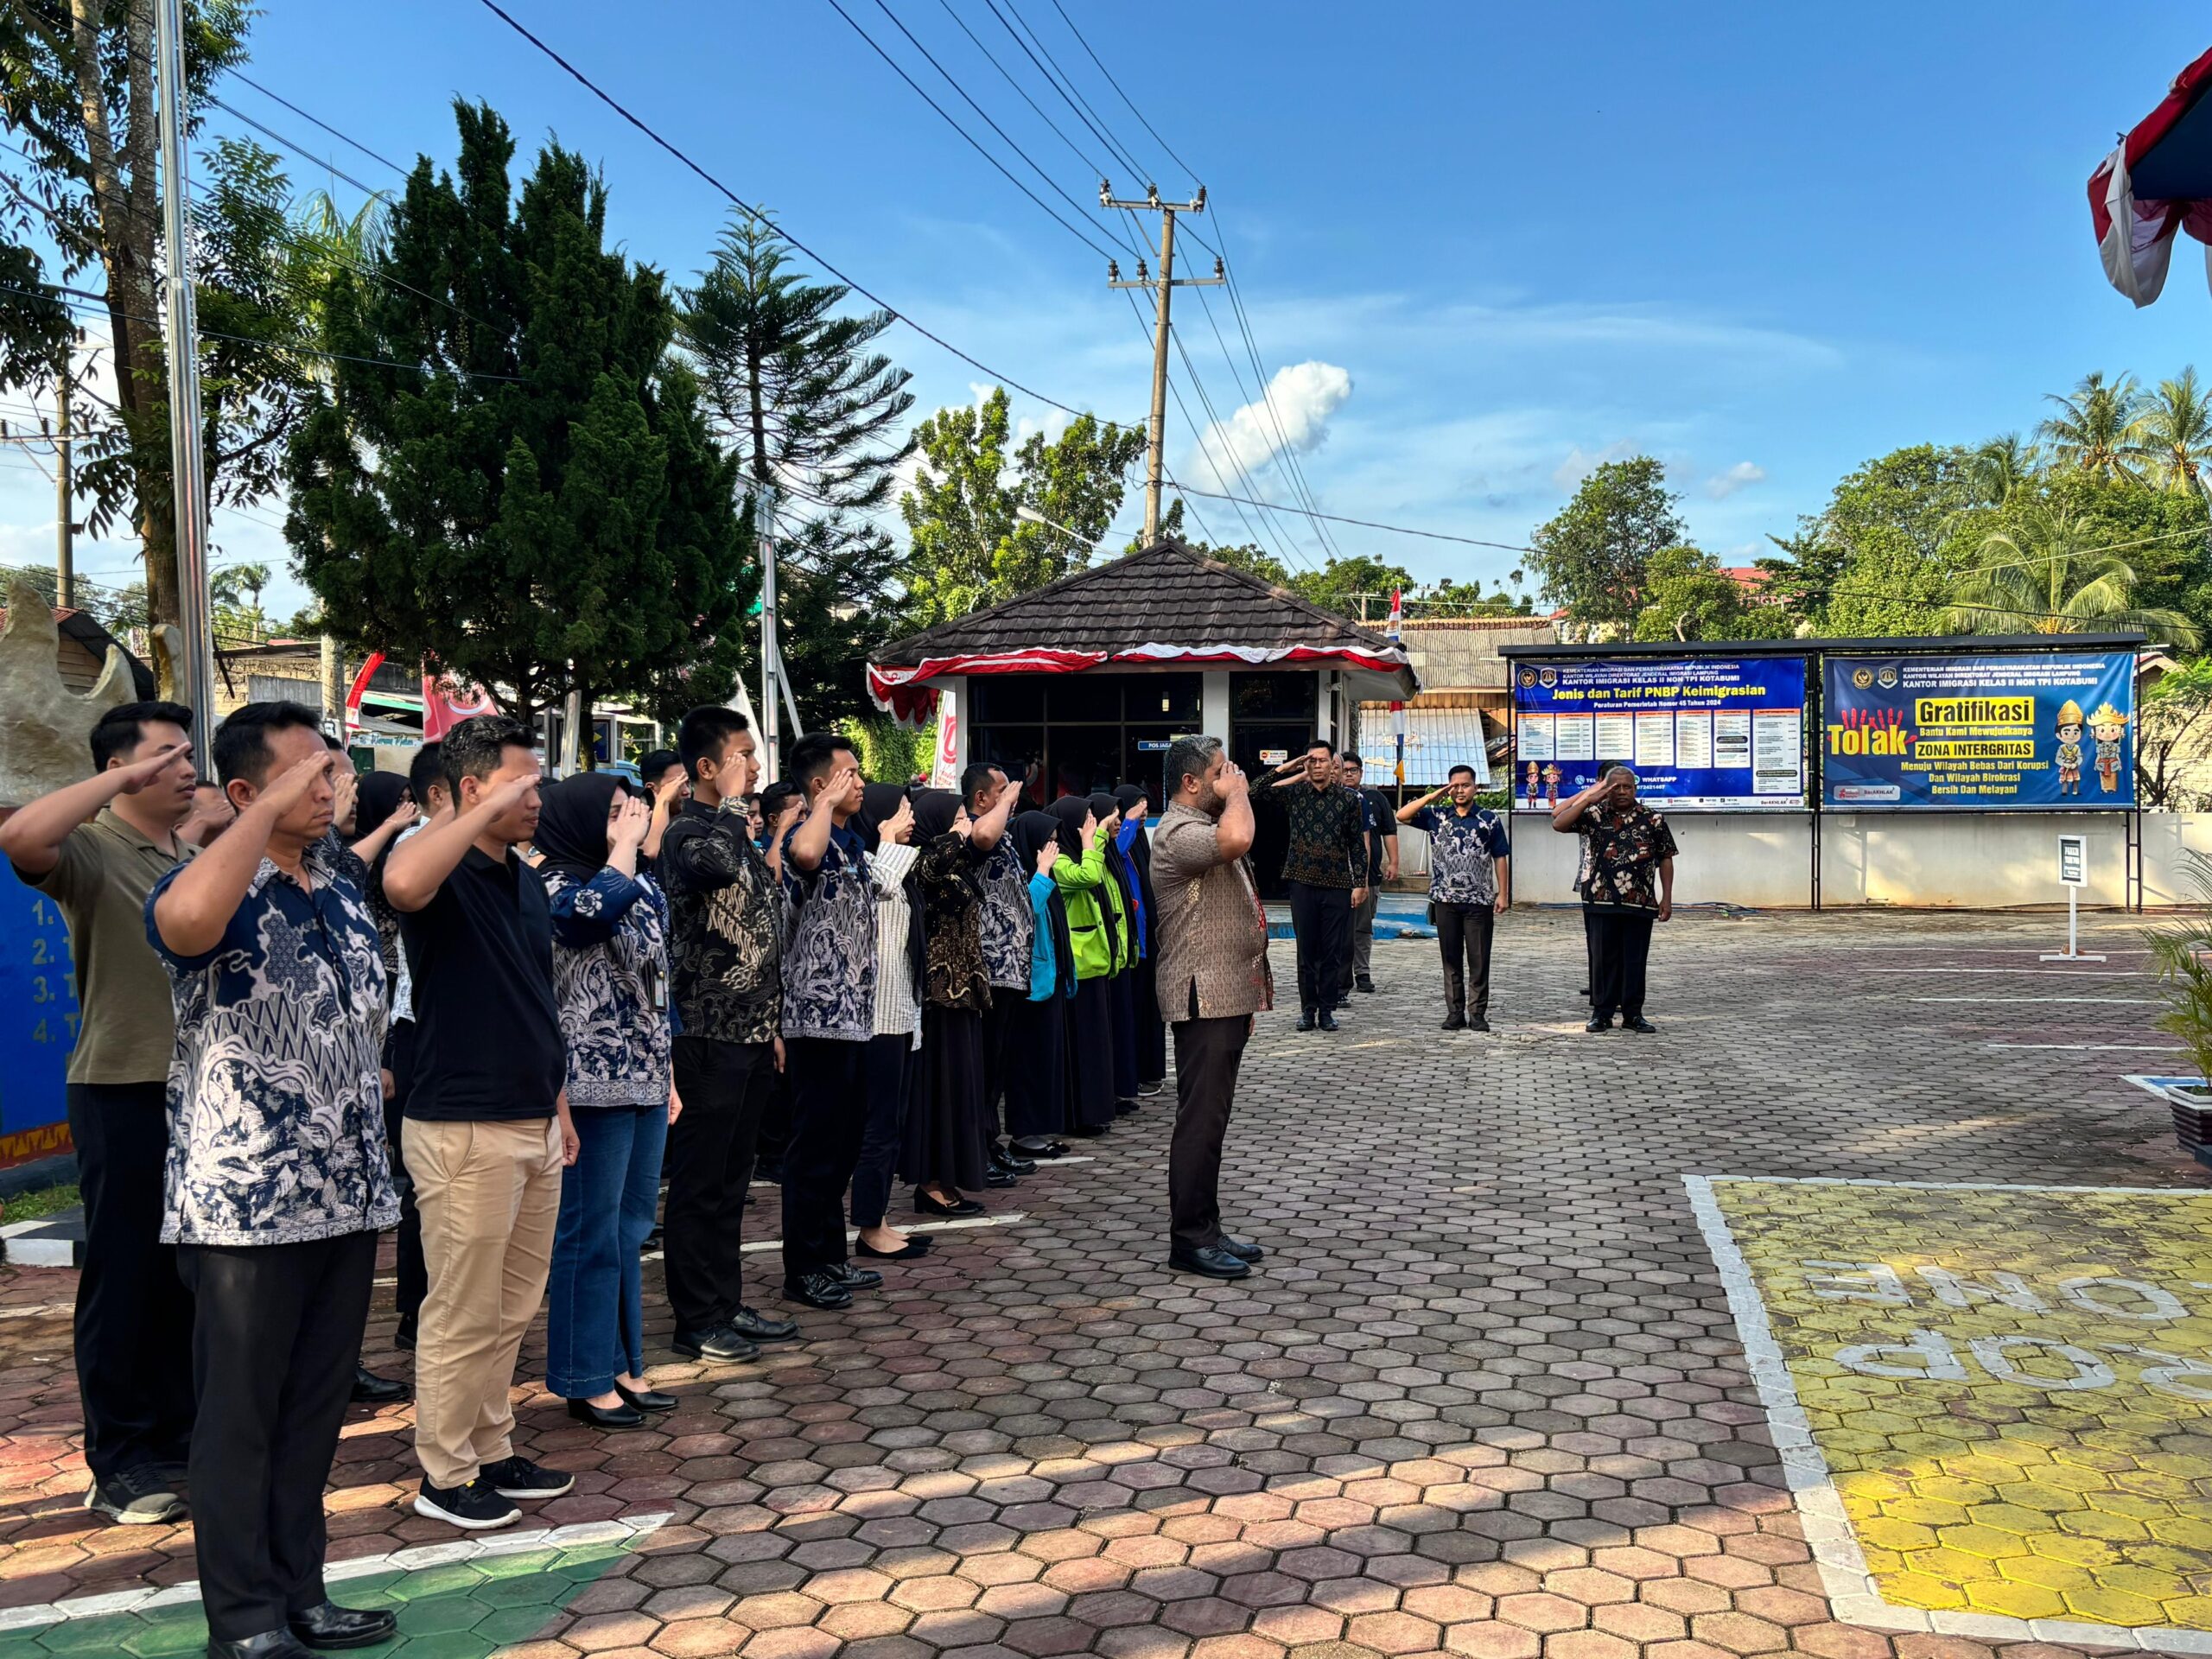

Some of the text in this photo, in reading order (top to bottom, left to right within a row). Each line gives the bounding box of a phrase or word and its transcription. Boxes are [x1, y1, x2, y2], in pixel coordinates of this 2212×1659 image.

[1552, 684, 1765, 700] Jenis dan Tarif PNBP Keimigrasian
[1920, 700, 2029, 722] Gratifikasi
[1827, 724, 1908, 755] Tolak
[1920, 728, 1943, 736] Bantu
[1946, 727, 1967, 736] Kami
[1918, 743, 2031, 756] ZONA INTERGRITAS
[1901, 760, 2049, 771] Menuju Wilayah Bebas Dari Korupsi
[1929, 772, 2020, 783] Dan Wilayah Birokrasi
[1932, 785, 2018, 794] Bersih Dan Melayani
[32, 899, 54, 925] 1.
[32, 938, 55, 965] 2.
[33, 976, 55, 1004] 3.
[33, 1019, 55, 1044] 4.
[1802, 1259, 2212, 1320] ONE
[1833, 1329, 2212, 1400] ROP
